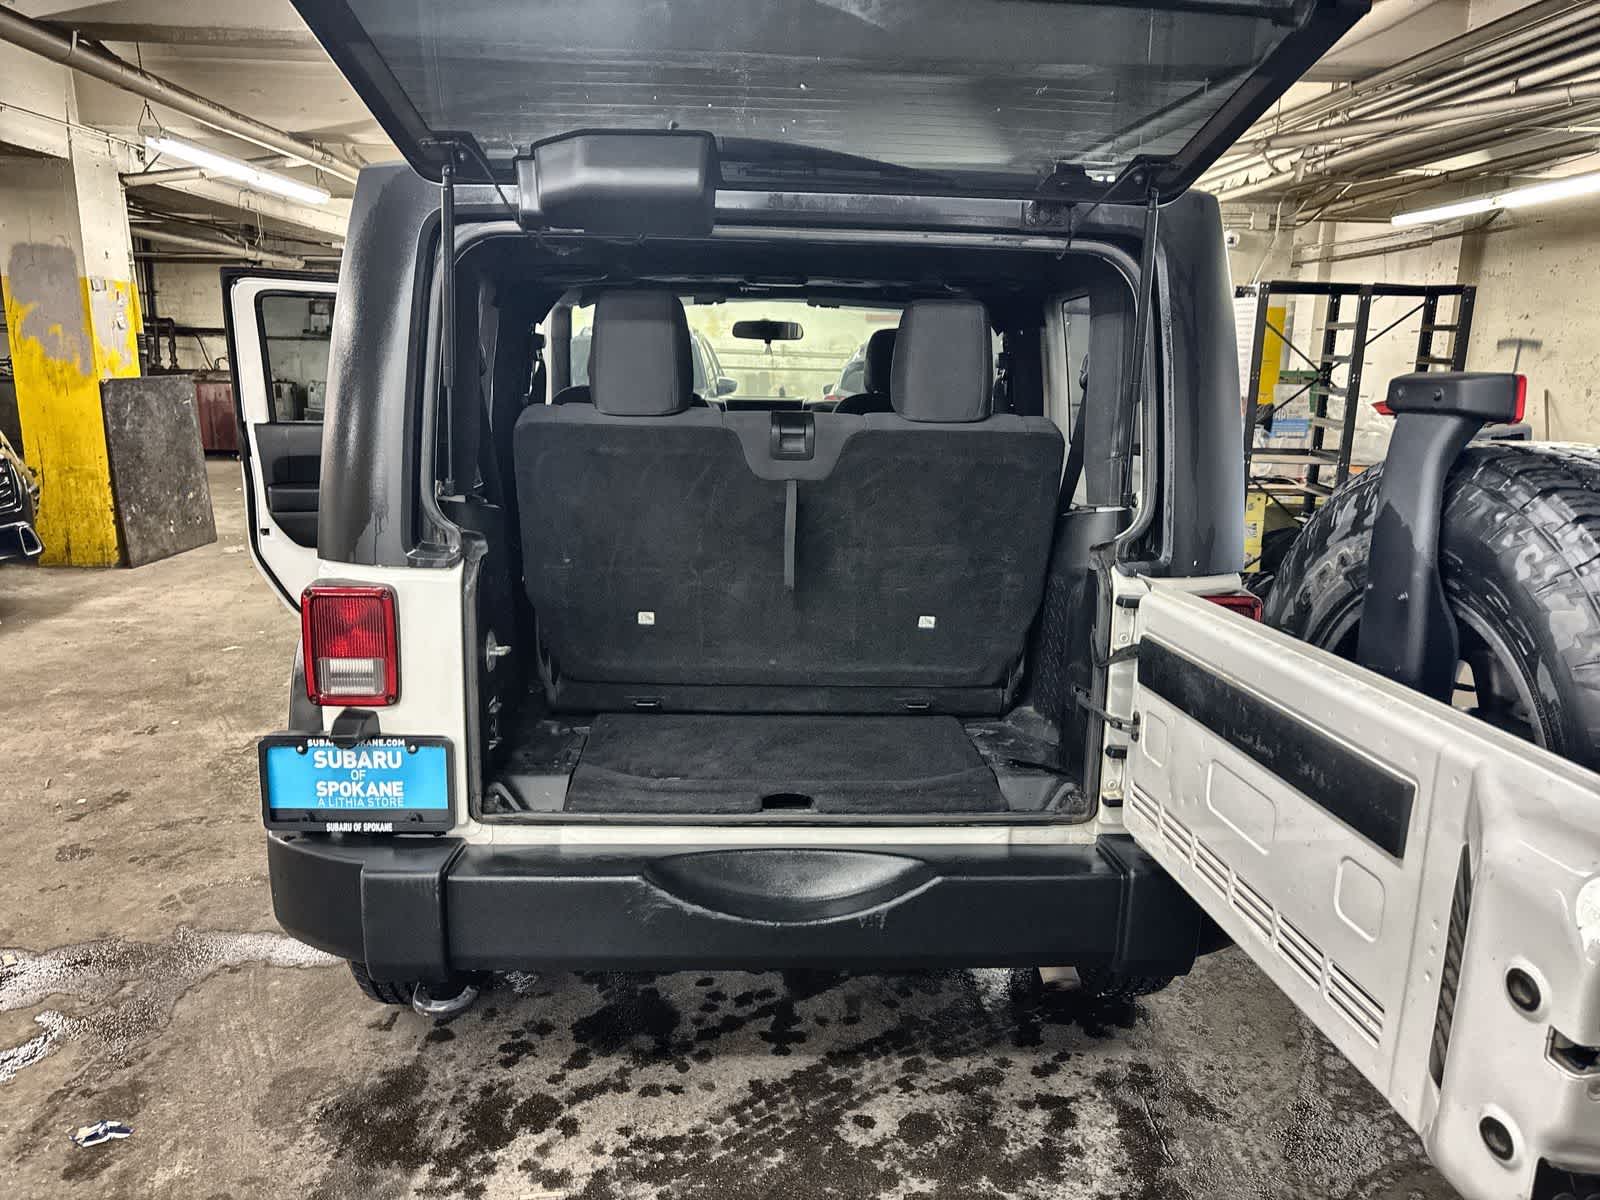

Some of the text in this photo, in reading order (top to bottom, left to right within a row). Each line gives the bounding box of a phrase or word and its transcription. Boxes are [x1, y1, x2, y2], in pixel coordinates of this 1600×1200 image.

[313, 750, 402, 769] SUBARU
[350, 770, 366, 780] OF
[316, 781, 404, 797] SPOKANE
[318, 798, 404, 808] A LITHIA STORE
[326, 822, 393, 832] SUBARU OF SPOKANE
